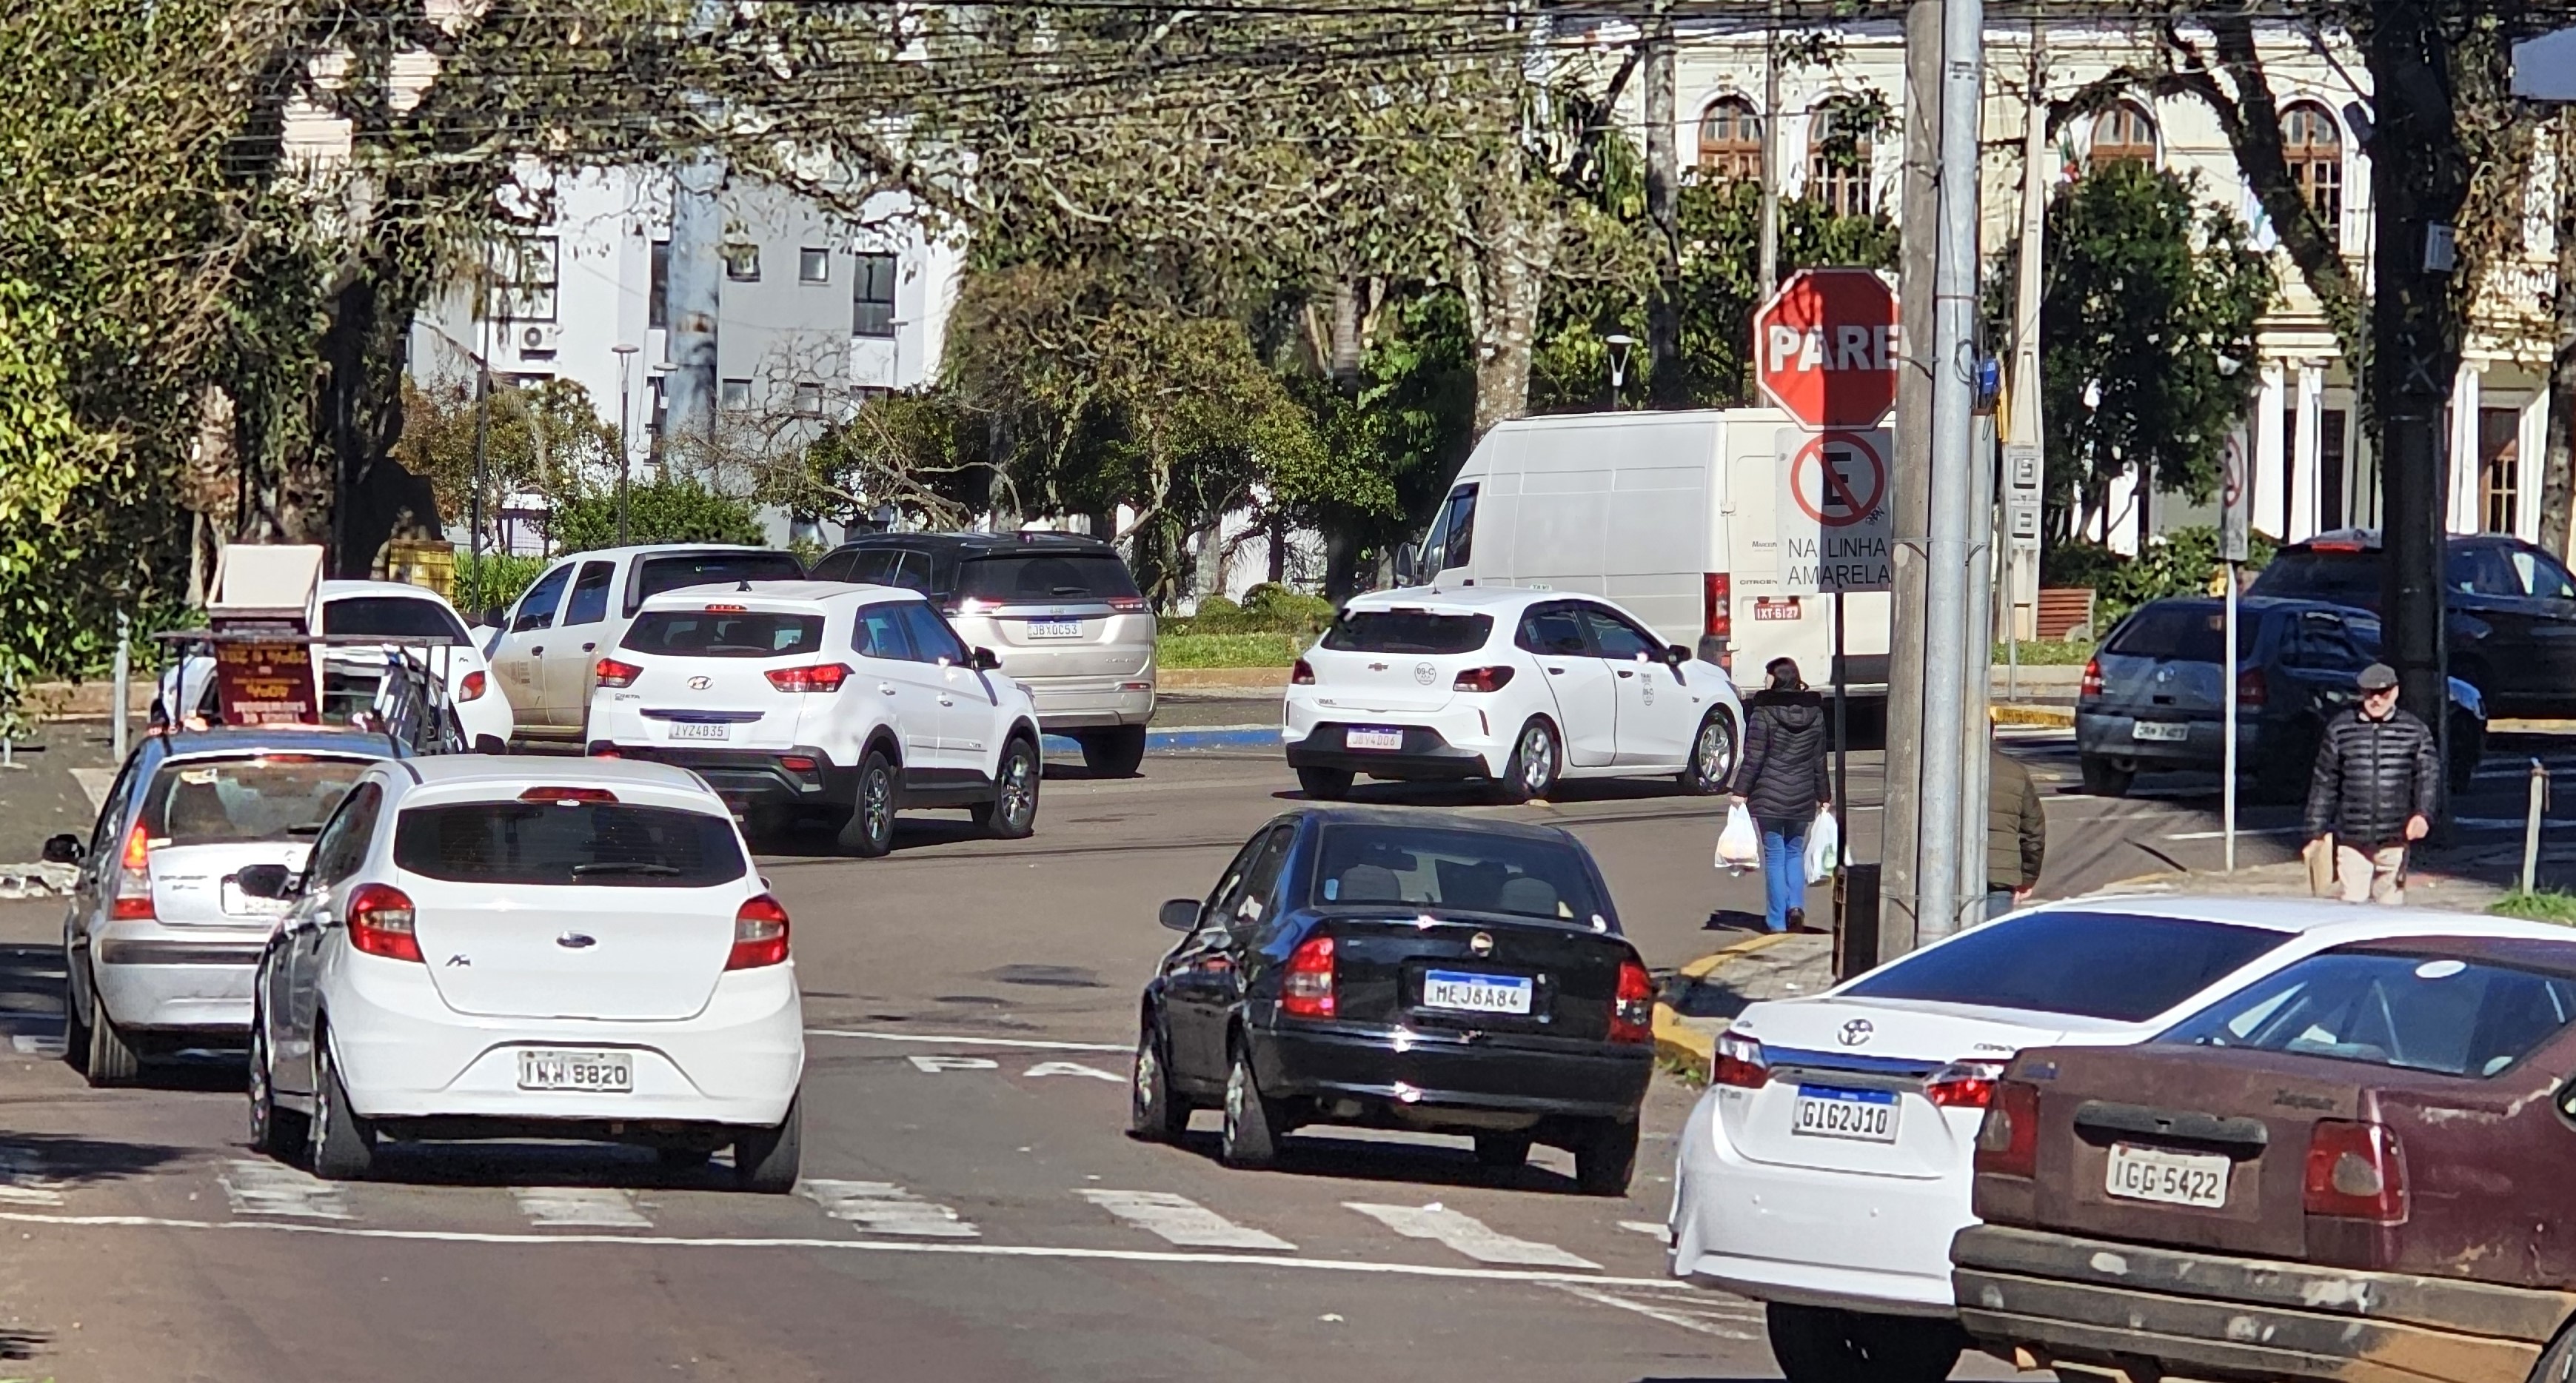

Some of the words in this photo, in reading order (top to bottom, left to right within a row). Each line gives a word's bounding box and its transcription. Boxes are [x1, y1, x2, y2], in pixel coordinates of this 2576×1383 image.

[1769, 325, 1900, 372] PARE
[1788, 538, 1818, 557] NA
[1828, 538, 1887, 557] LINHA
[1787, 564, 1892, 586] AMARELA
